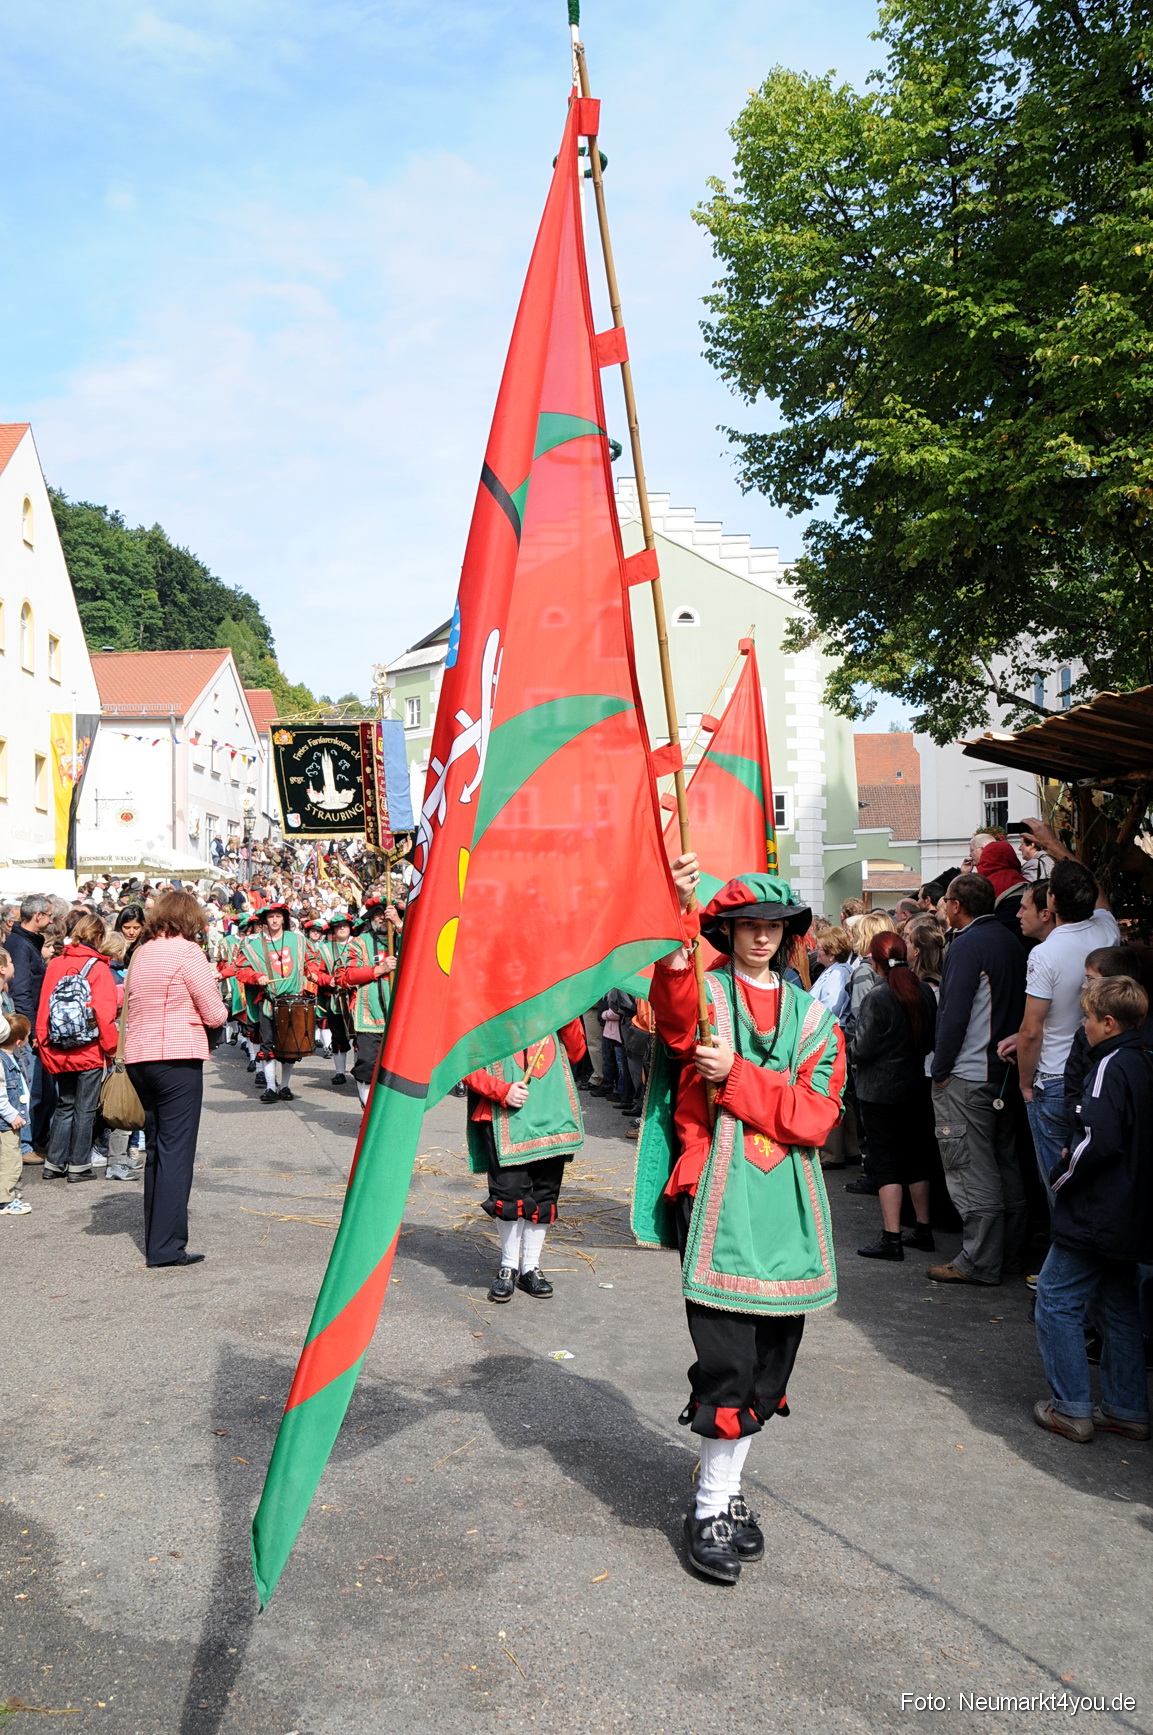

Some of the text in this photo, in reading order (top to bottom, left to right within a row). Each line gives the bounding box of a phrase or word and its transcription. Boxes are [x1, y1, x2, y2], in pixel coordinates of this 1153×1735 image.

[293, 744, 309, 761] Freies
[307, 736, 351, 751] Fanfarenkorps
[304, 803, 364, 821] STRAUBING
[79, 855, 113, 863] RIEDENBURGER
